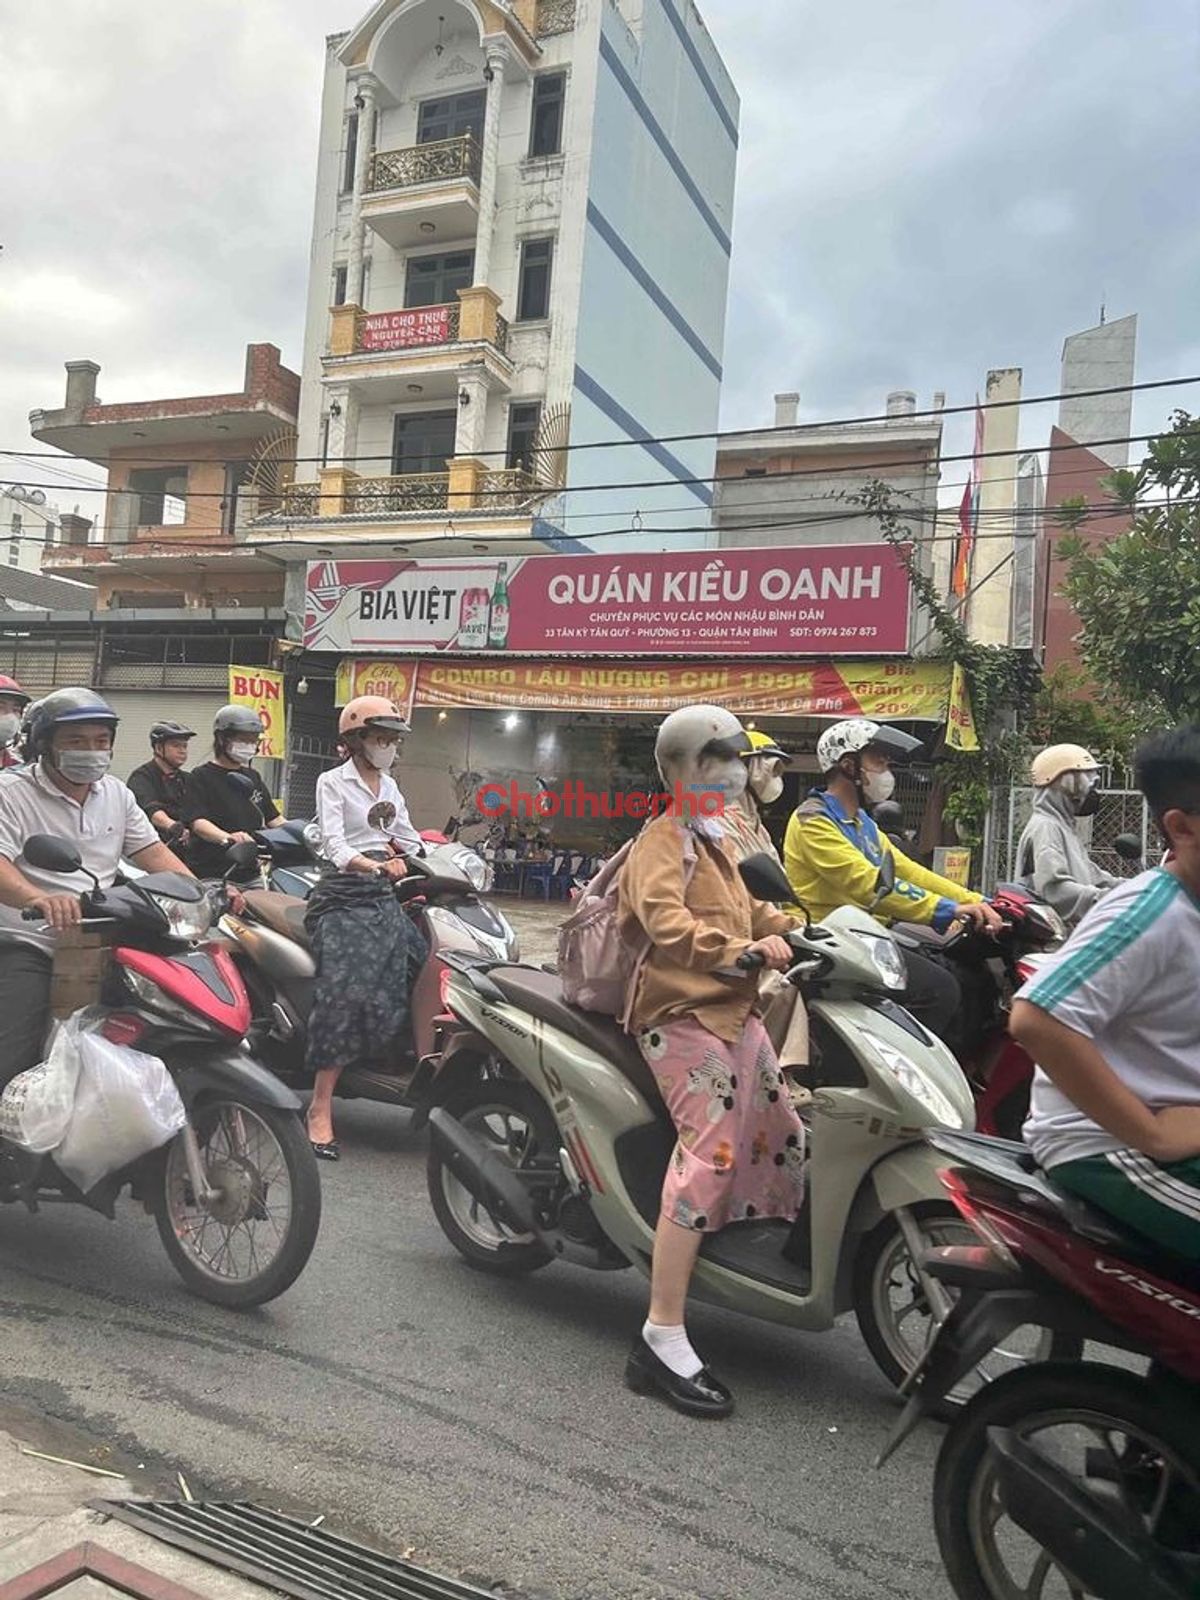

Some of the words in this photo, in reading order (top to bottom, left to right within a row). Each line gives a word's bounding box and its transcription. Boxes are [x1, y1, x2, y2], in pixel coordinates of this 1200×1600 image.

[391, 314, 415, 327] CHO
[548, 565, 652, 604] QUÁN
[662, 559, 749, 602] KIỀU
[759, 565, 882, 601] OANH
[589, 610, 631, 622] CHUYÊN
[632, 611, 661, 623] PHỤC
[663, 611, 678, 623] VỤ
[680, 609, 703, 622] CÁC
[705, 610, 732, 622] MÓN
[734, 609, 767, 624] NHẬU
[768, 608, 797, 621] BÌNH
[798, 607, 825, 621] DÂN
[556, 626, 575, 638] TÂN
[590, 626, 609, 638] TÂN
[637, 626, 680, 638] PHƯỜNG
[681, 628, 691, 638] 13
[698, 626, 728, 639] QUẬN
[730, 626, 751, 638] TÂN
[752, 626, 778, 637] BÌNH
[814, 626, 838, 637] 0974
[840, 626, 857, 637] 267
[859, 626, 877, 637] 873
[885, 664, 916, 676] Bia
[233, 673, 280, 700] BÚN
[431, 668, 517, 685] COMBO
[740, 671, 815, 690] 199K
[815, 696, 843, 711] Phê
[875, 702, 920, 715] 20%
[1095, 1260, 1200, 1320] VISIO
